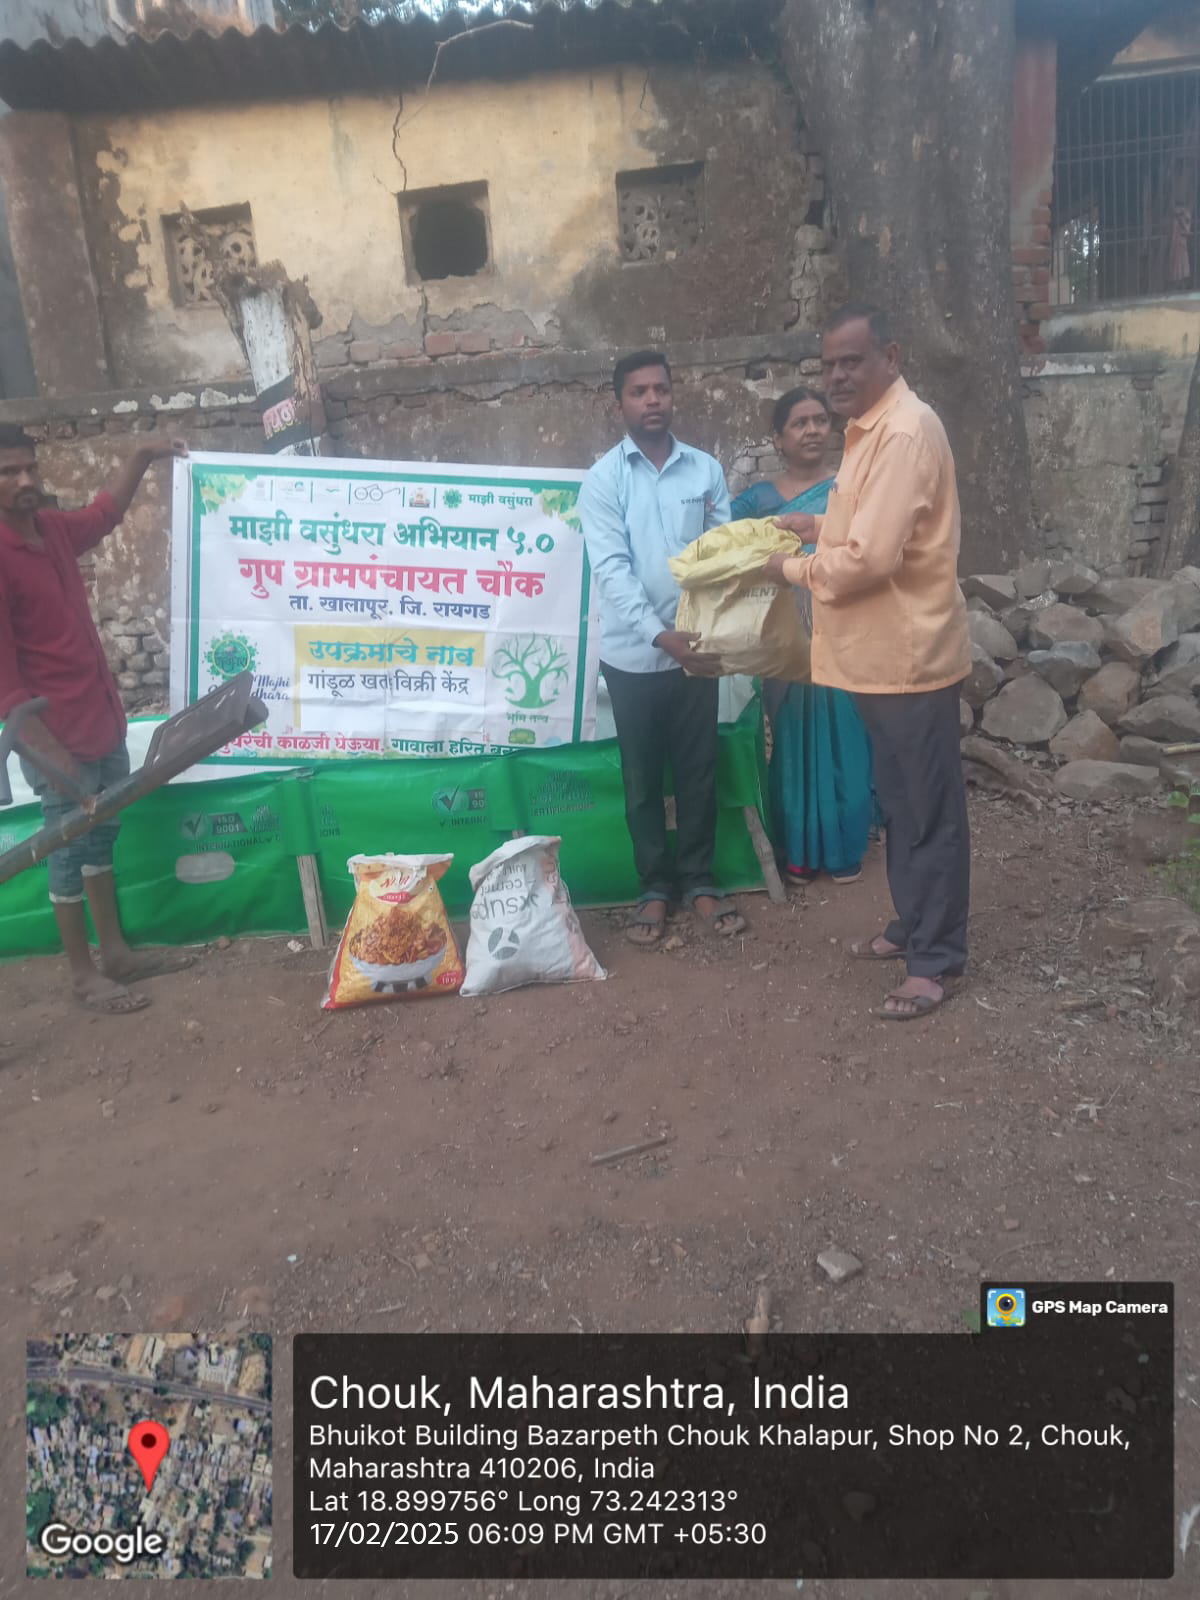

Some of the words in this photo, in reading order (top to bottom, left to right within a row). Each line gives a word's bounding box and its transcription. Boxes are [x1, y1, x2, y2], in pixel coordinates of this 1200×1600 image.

[468, 491, 495, 507] माझी
[498, 493, 533, 510] वसुंधरा
[228, 509, 293, 546] माझी
[299, 511, 387, 556] वसुंधरा
[393, 515, 499, 552] अभियान
[506, 525, 556, 556] ५.०
[293, 552, 468, 596] ग्रामपंचायत
[475, 559, 546, 599] चौक
[288, 594, 314, 611] ता.
[399, 594, 427, 617] जि.
[432, 601, 492, 620] रायगड
[308, 636, 419, 664] उपक्रमाचे
[425, 644, 476, 668] नाव
[307, 669, 356, 698] गांडूळ
[393, 668, 437, 693] विक्री
[440, 670, 471, 695] केंद्र
[277, 732, 331, 751] काळजी
[215, 824, 240, 834] 9001
[217, 815, 235, 823] ISO
